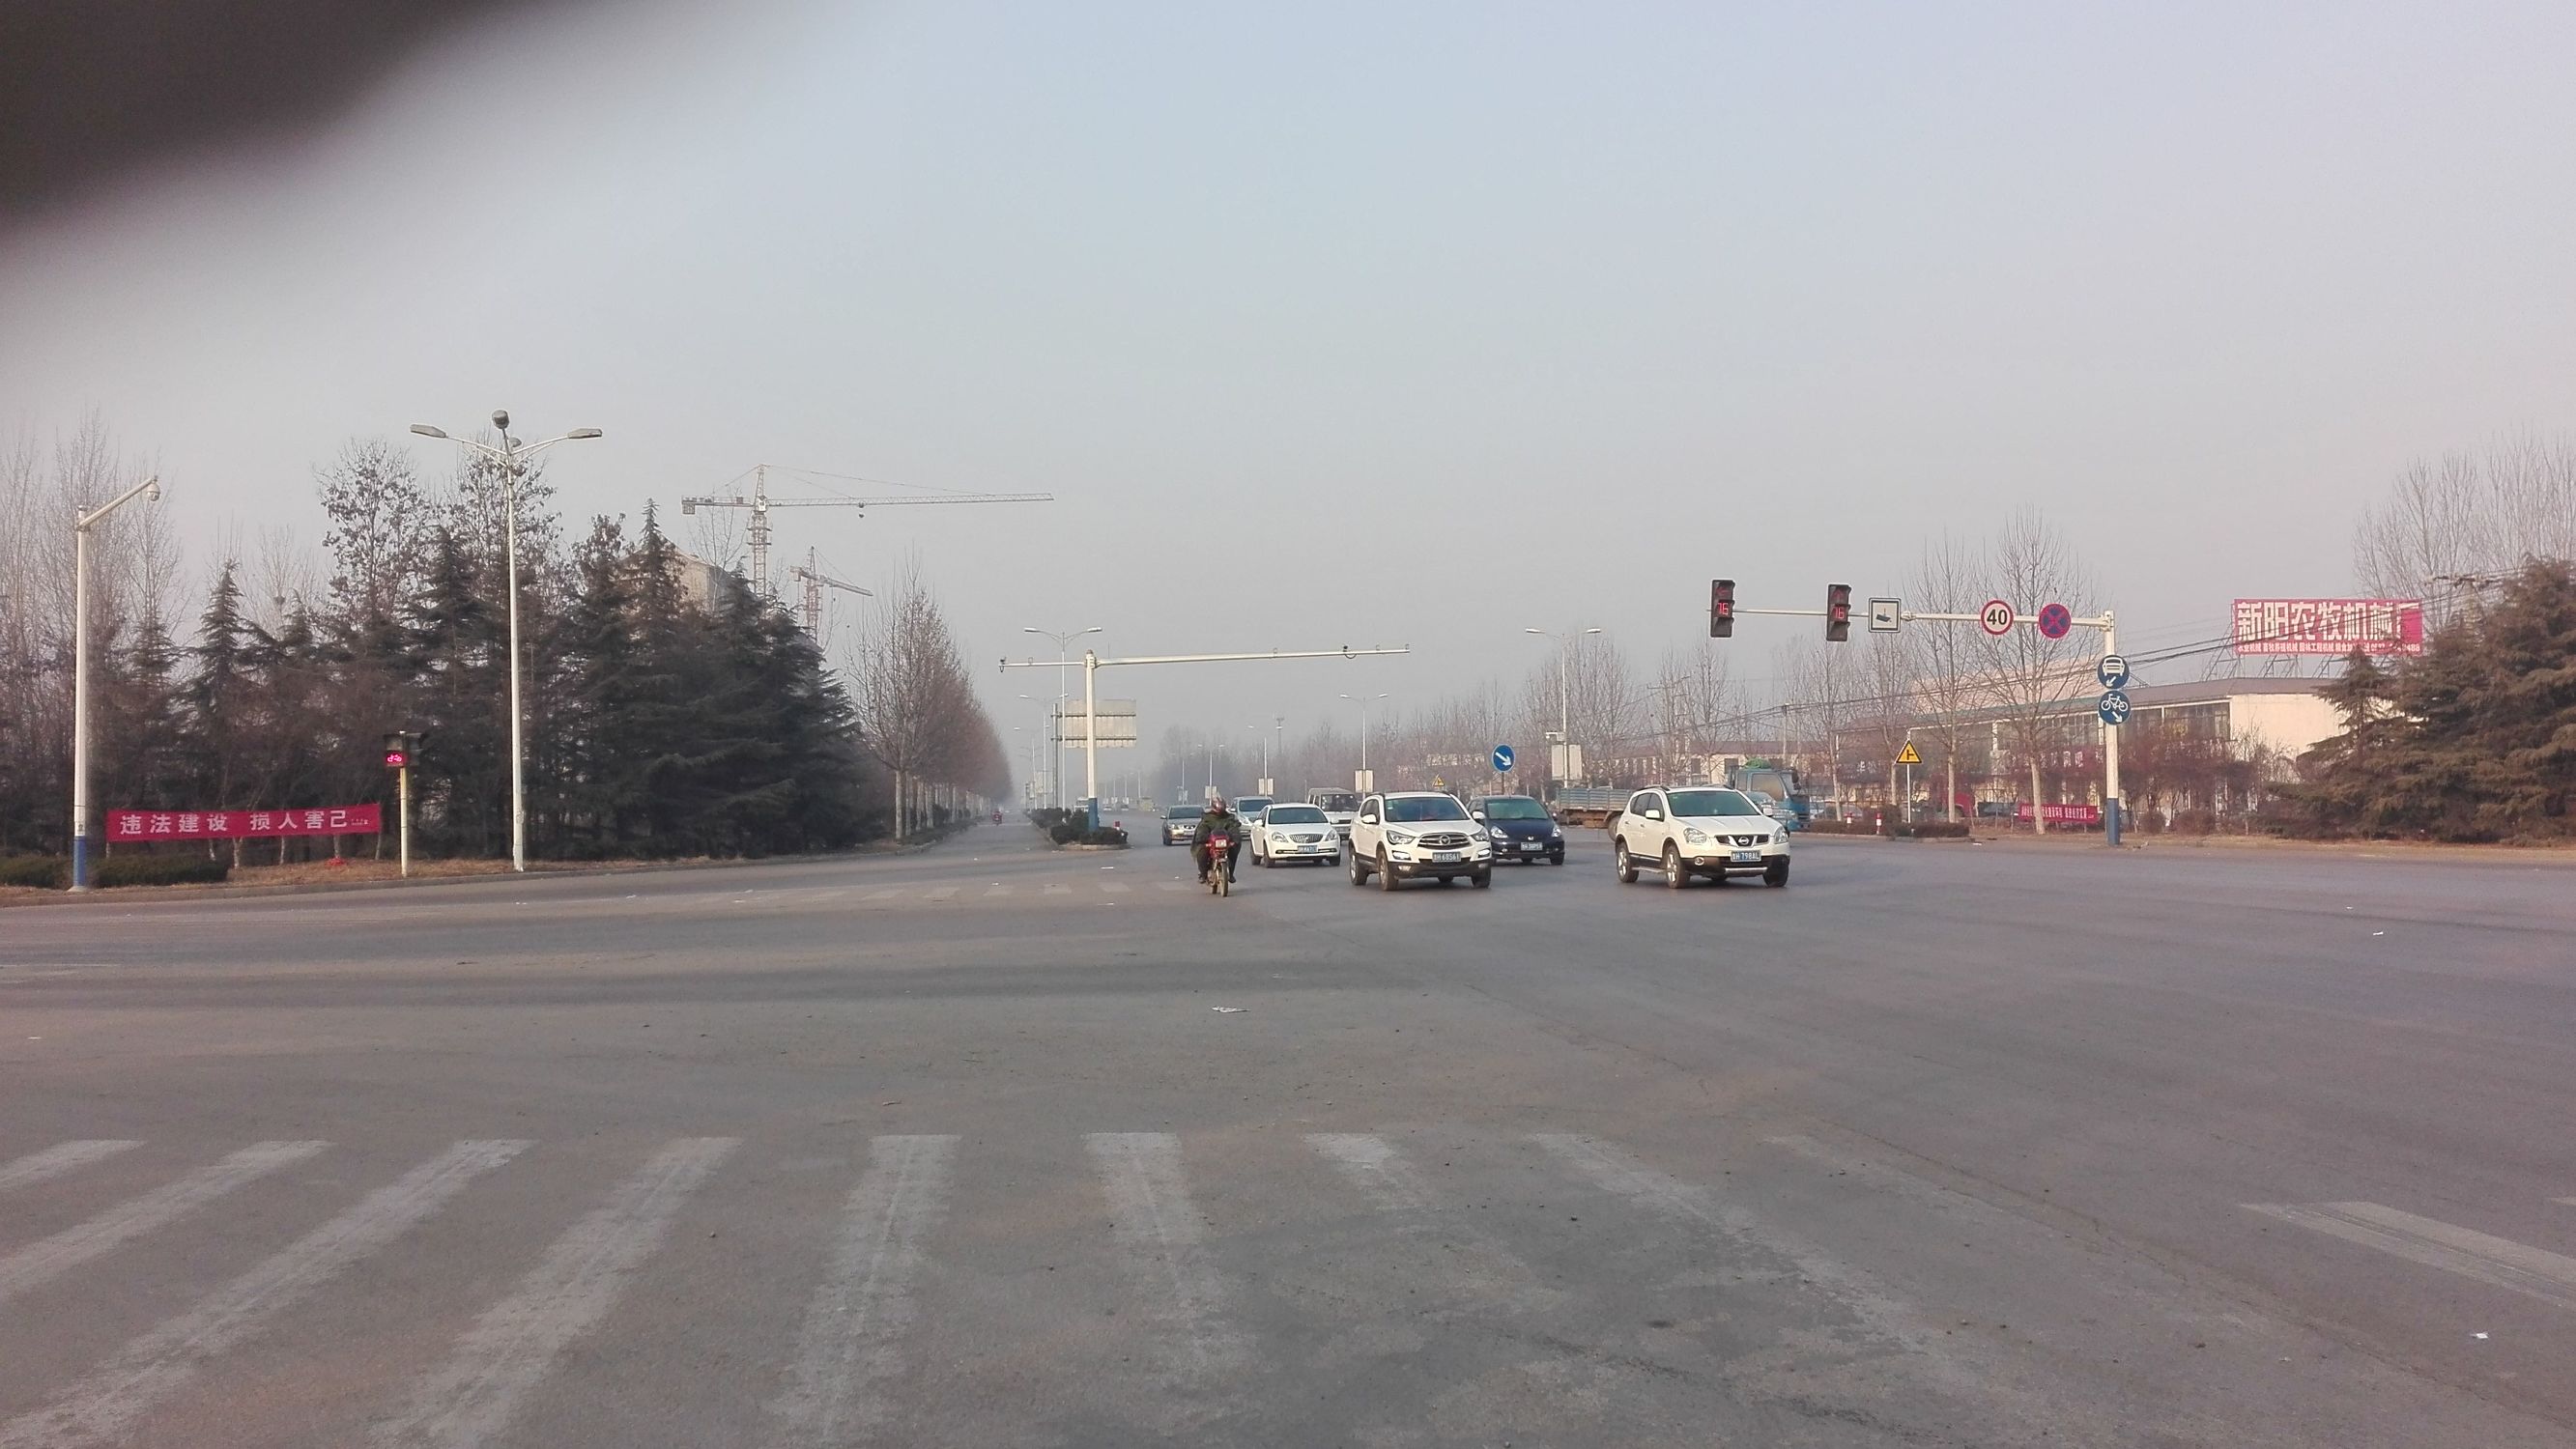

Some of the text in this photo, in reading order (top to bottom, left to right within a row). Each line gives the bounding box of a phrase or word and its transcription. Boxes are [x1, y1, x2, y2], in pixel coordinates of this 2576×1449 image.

[1987, 609, 2007, 625] 40
[120, 813, 228, 835] 违法建设
[249, 810, 348, 832] 损人害己
